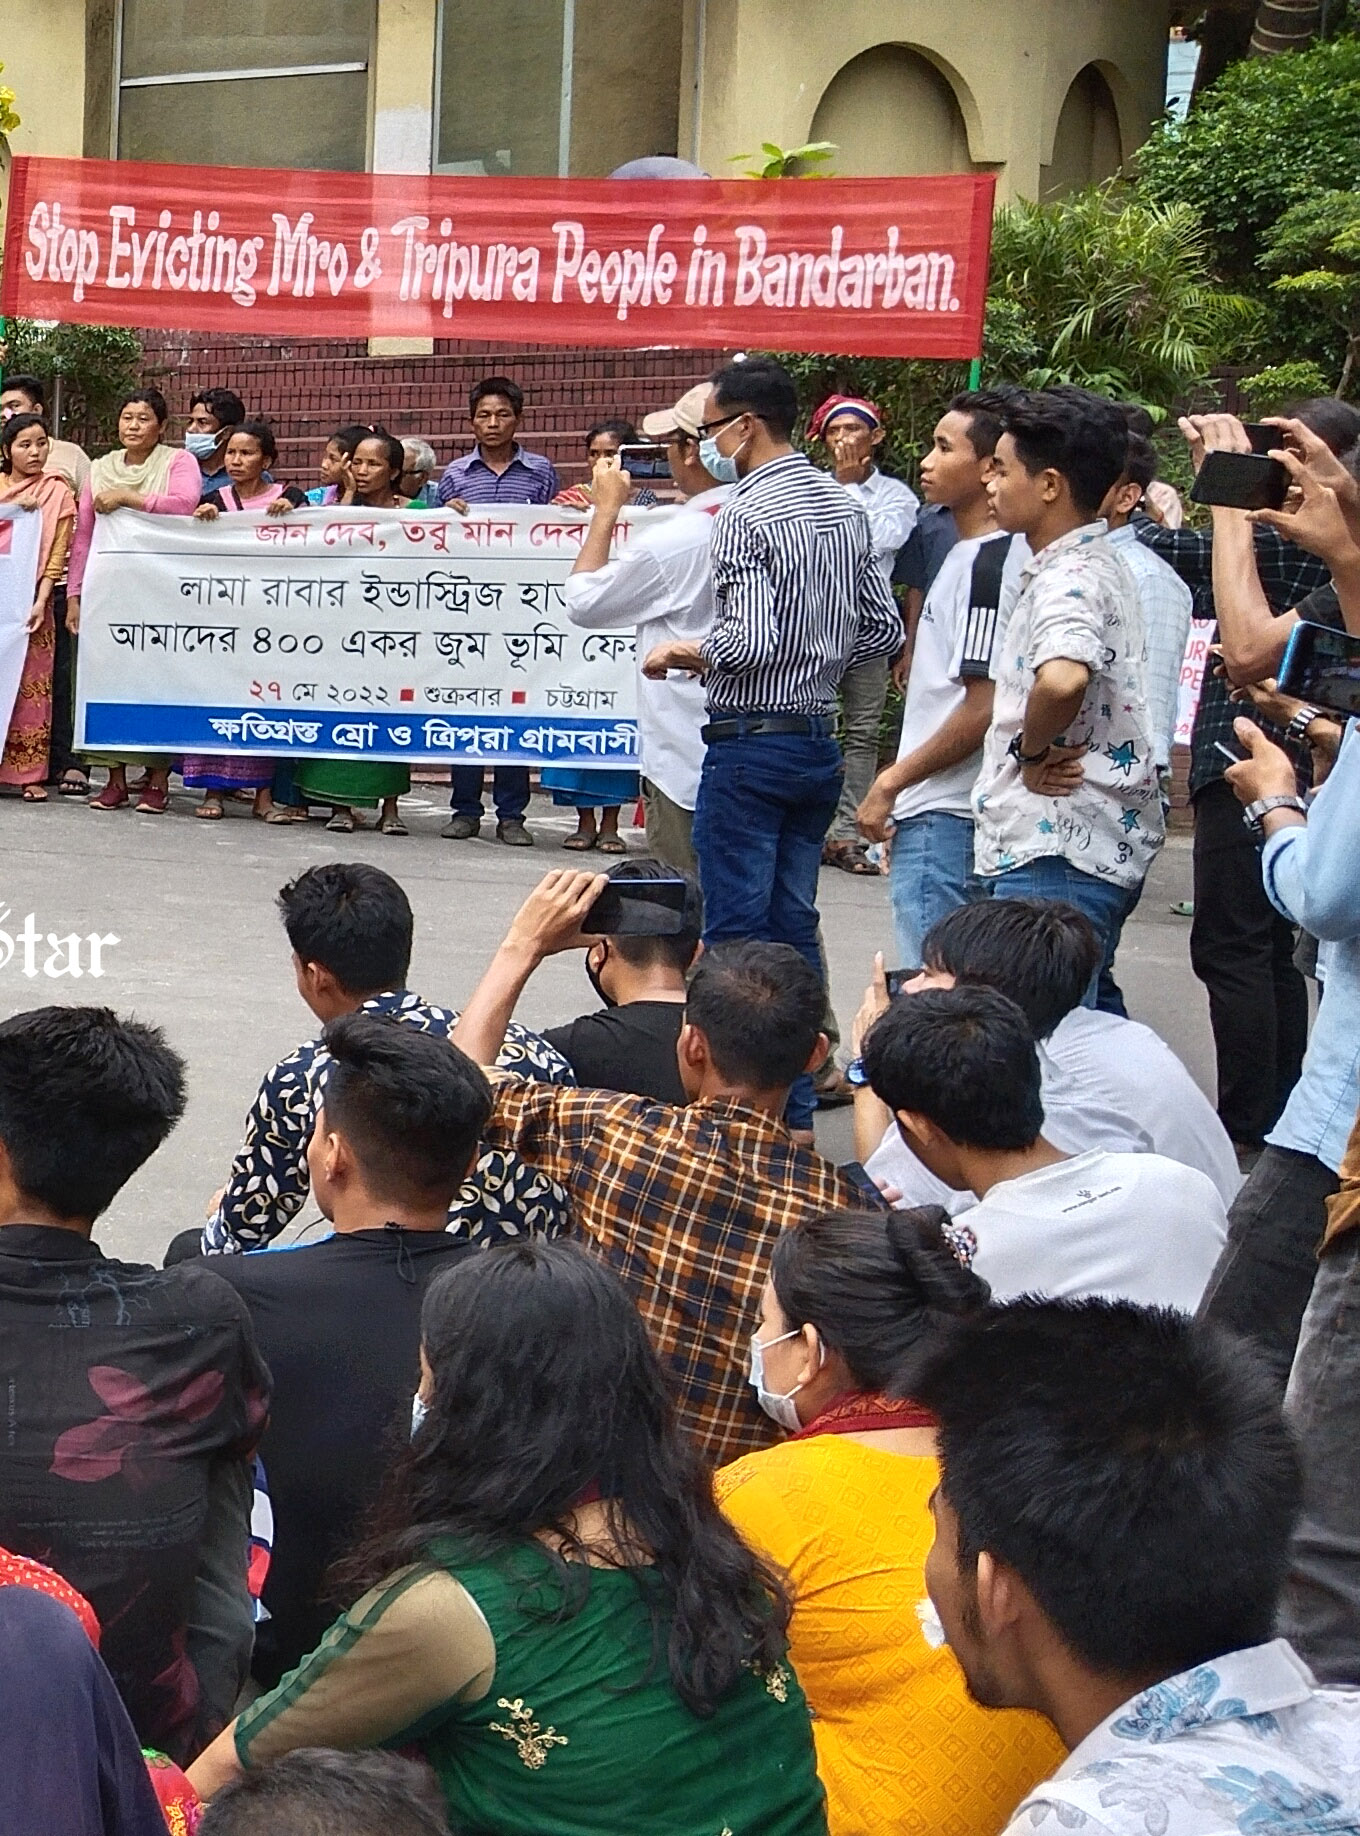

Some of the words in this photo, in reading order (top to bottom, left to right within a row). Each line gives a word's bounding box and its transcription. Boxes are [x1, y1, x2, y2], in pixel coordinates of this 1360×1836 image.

[25, 201, 99, 302] Stop
[106, 205, 264, 307] Evicting
[266, 212, 349, 297] Mro
[353, 227, 382, 289] &
[390, 215, 541, 319] Tripura
[551, 221, 678, 321] People
[684, 224, 726, 307] in
[733, 225, 960, 312] Bandarban.
[253, 520, 312, 546] জান
[323, 521, 386, 551] দেব,
[400, 521, 452, 553] তবু
[461, 518, 519, 547] মান
[530, 522, 589, 547] দেব
[178, 573, 251, 606] লামা
[261, 576, 349, 608] রাবার
[360, 569, 507, 614] ইন্ডাস্ট্রিজ
[108, 621, 240, 652] আমাদের
[253, 626, 324, 655] ৪০০
[342, 629, 421, 659] একর
[432, 629, 492, 669] জুম
[502, 622, 568, 671] ভূমি
[249, 679, 282, 701] ২৭
[292, 682, 318, 702] মে
[327, 683, 390, 707] ২০২২
[424, 684, 503, 708] শুক্রবার
[545, 682, 618, 711] চট্টগ্রাম
[209, 712, 322, 745] ক্ষতিগ্রস্ত
[331, 722, 378, 750] ম্রো
[387, 726, 412, 746] ও
[422, 722, 514, 756] ত্রিপুরা
[518, 722, 639, 756] গ্রামবাসী
